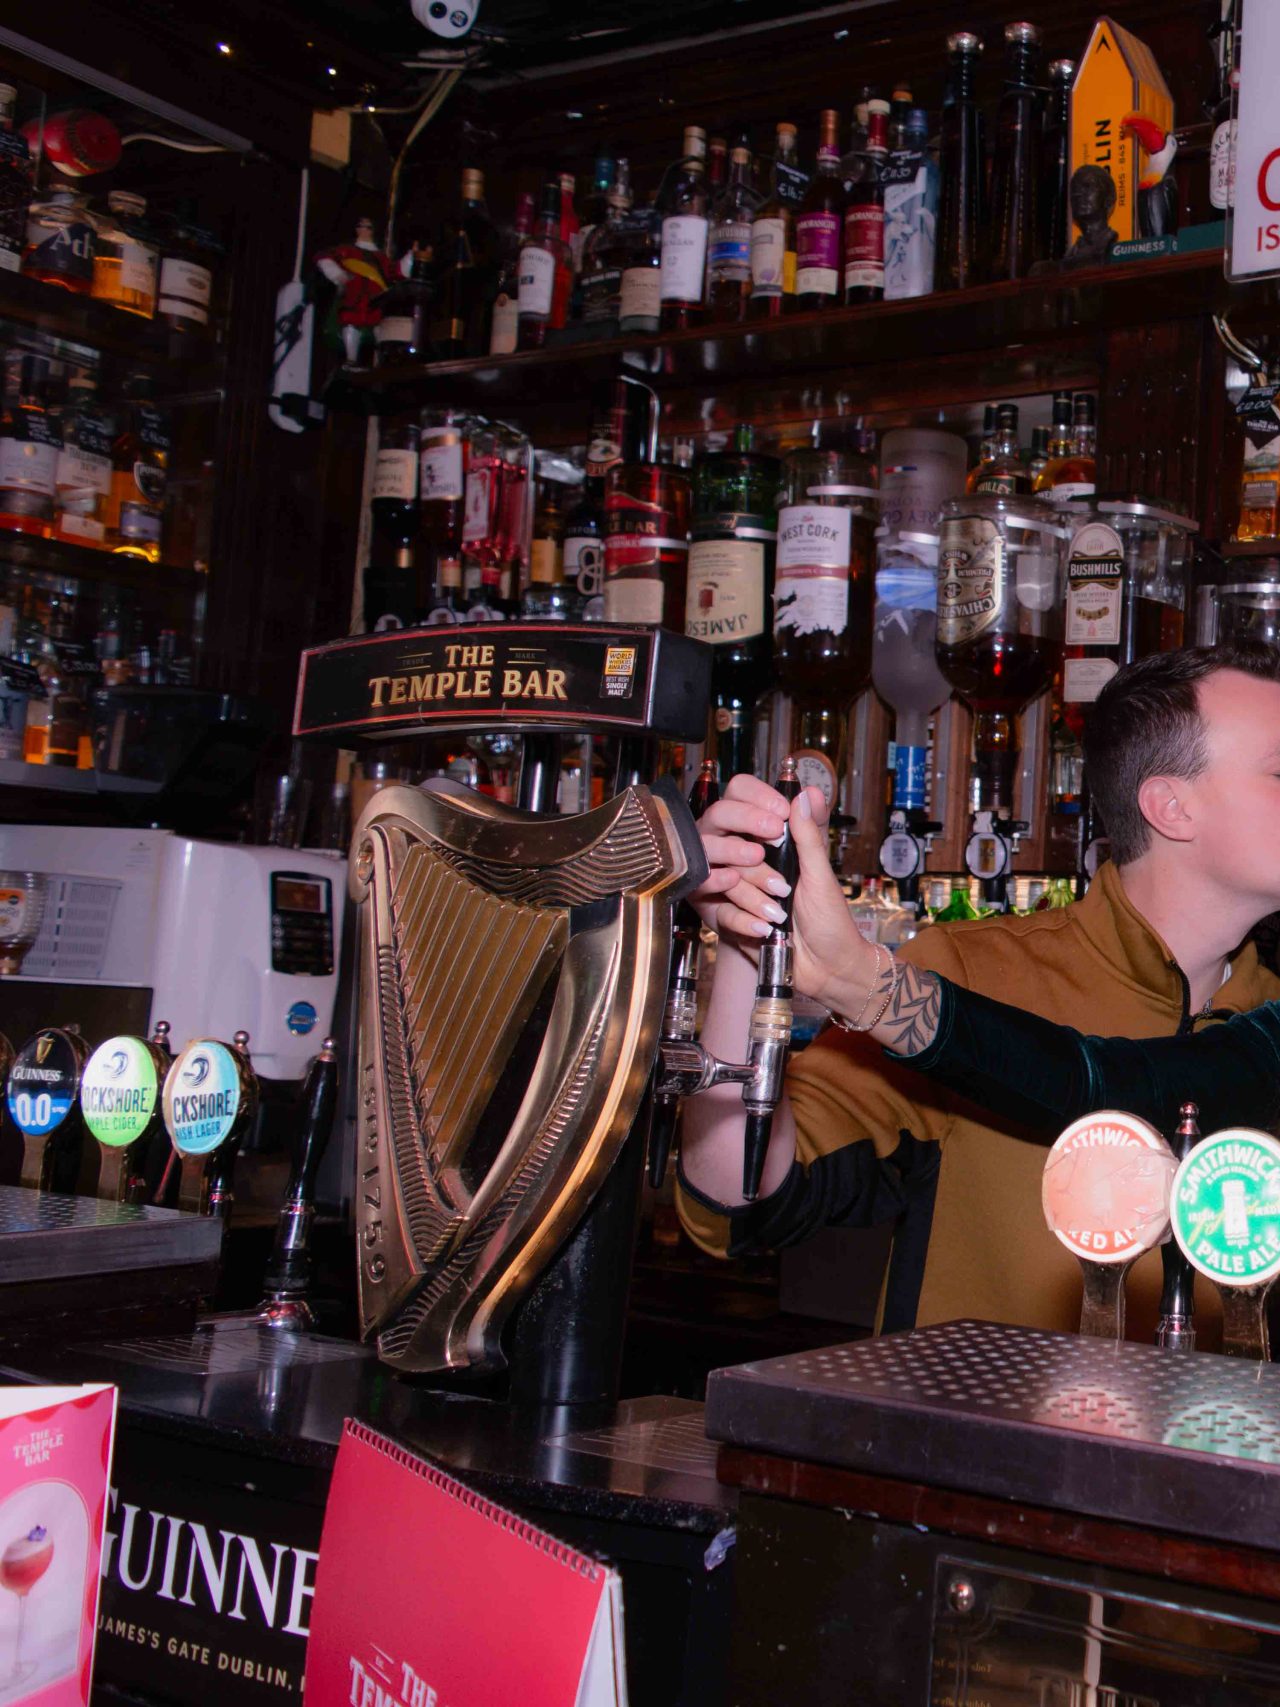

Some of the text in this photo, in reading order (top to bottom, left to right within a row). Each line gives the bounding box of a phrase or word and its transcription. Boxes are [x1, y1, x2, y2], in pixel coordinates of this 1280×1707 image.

[1256, 224, 1280, 251] IS
[1113, 241, 1165, 256] GUINNESS
[781, 523, 839, 541] WEST CORK
[1070, 561, 1121, 578] BUSHMILLS
[949, 598, 994, 617] CHIVAS
[445, 645, 495, 668] THE
[609, 652, 633, 661] WORLD
[608, 664, 632, 672] AWARDS
[368, 669, 568, 708] TEMPLE BAR
[606, 682, 628, 690] SINGLE
[12, 1066, 63, 1082] GUINNESS
[15, 1093, 51, 1126] 0.0
[83, 1087, 149, 1115] OCKSHORE
[173, 1089, 234, 1124] CKSHORE
[113, 1116, 140, 1131] CIDER
[195, 1122, 223, 1140] LAGER
[362, 1165, 386, 1274] 1759
[1196, 1242, 1245, 1273] PALE
[30, 1431, 50, 1441] THE
[12, 1433, 65, 1459] TEMPLE
[24, 1450, 50, 1467] BAR
[102, 1487, 319, 1637] UINNE
[167, 1637, 210, 1665] GATE
[218, 1652, 292, 1690] DUBLIN,
